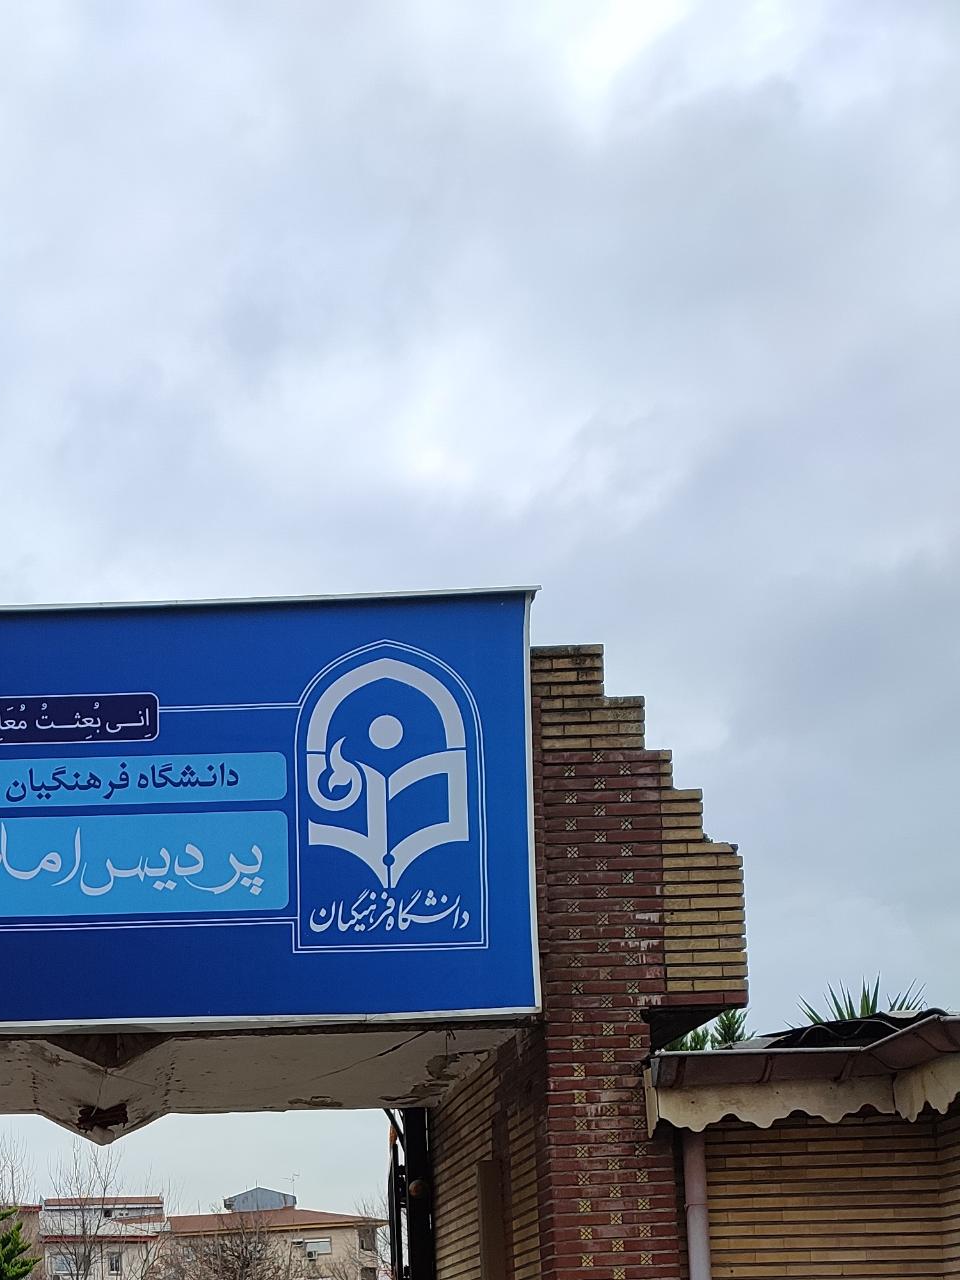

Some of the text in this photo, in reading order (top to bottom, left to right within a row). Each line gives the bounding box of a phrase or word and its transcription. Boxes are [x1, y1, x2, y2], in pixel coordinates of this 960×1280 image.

[5, 761, 130, 803] فرهنگیان
[136, 761, 240, 790] دانشگاه
[80, 842, 265, 896] پردیس
[309, 888, 470, 933] دانشگاه فرهنگیان
